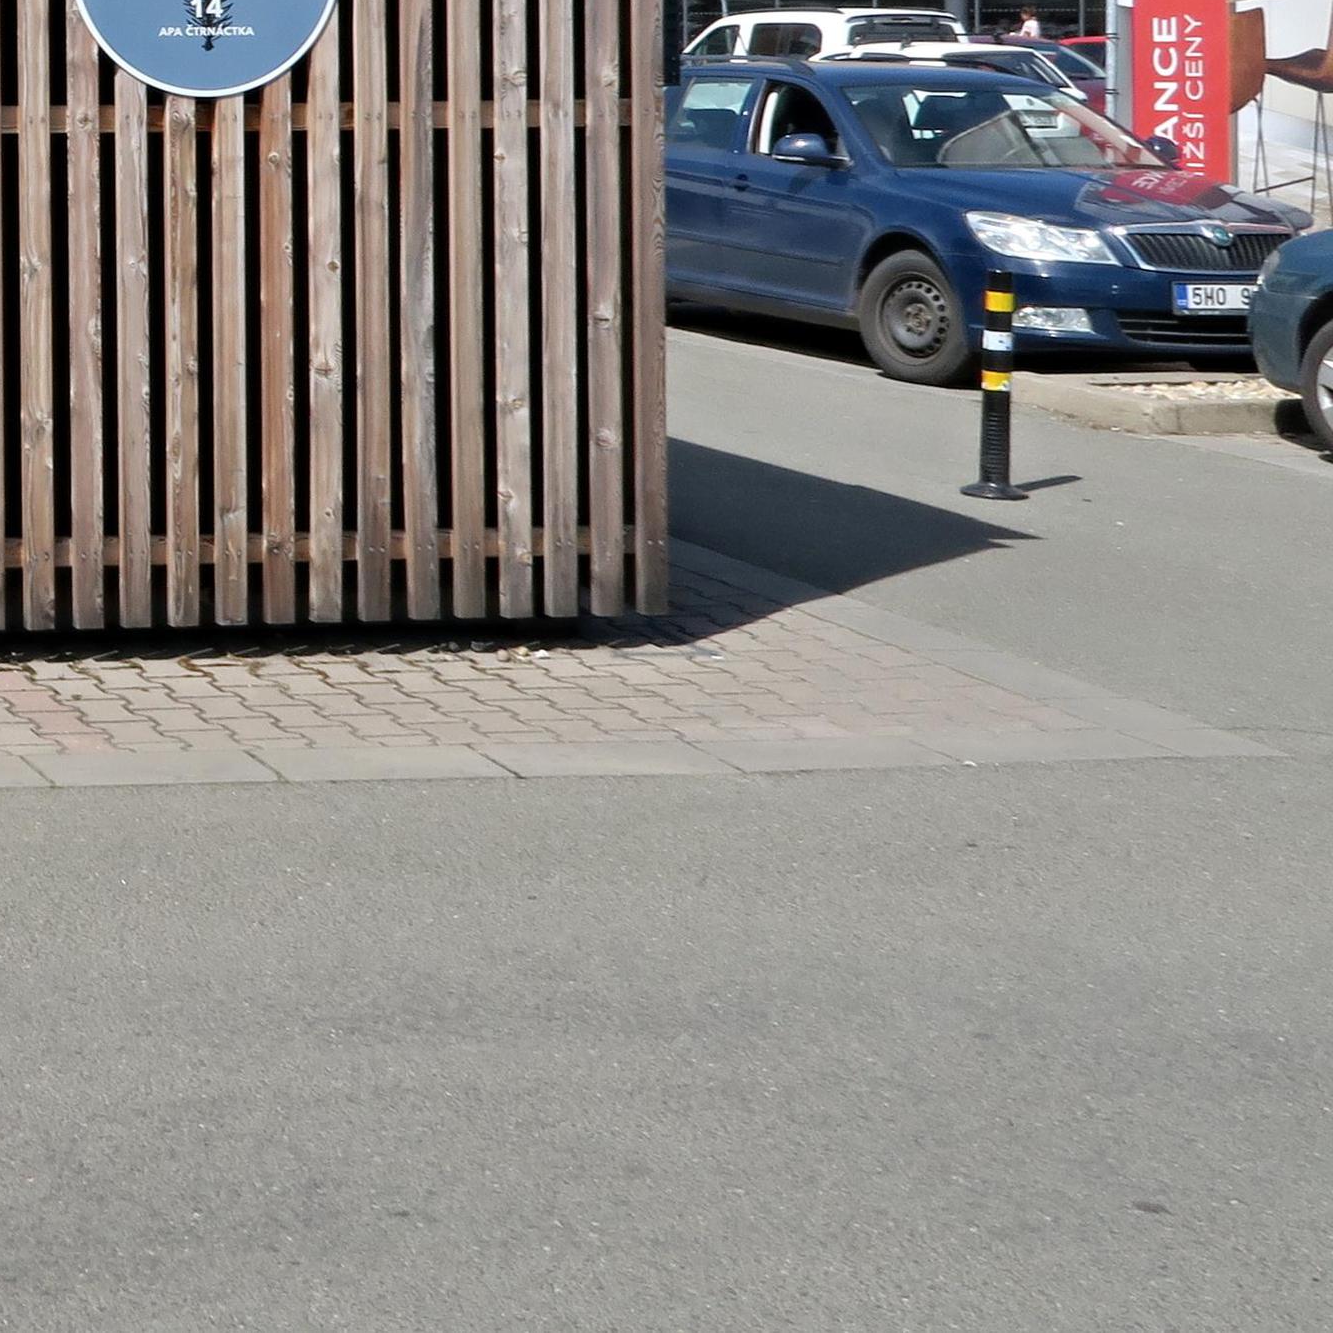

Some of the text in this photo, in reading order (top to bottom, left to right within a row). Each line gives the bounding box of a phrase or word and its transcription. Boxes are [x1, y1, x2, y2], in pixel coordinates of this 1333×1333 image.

[158, 23, 255, 37] APA ČTRNÁCTKA
[1183, 14, 1205, 177] IŽŠÍ CENY
